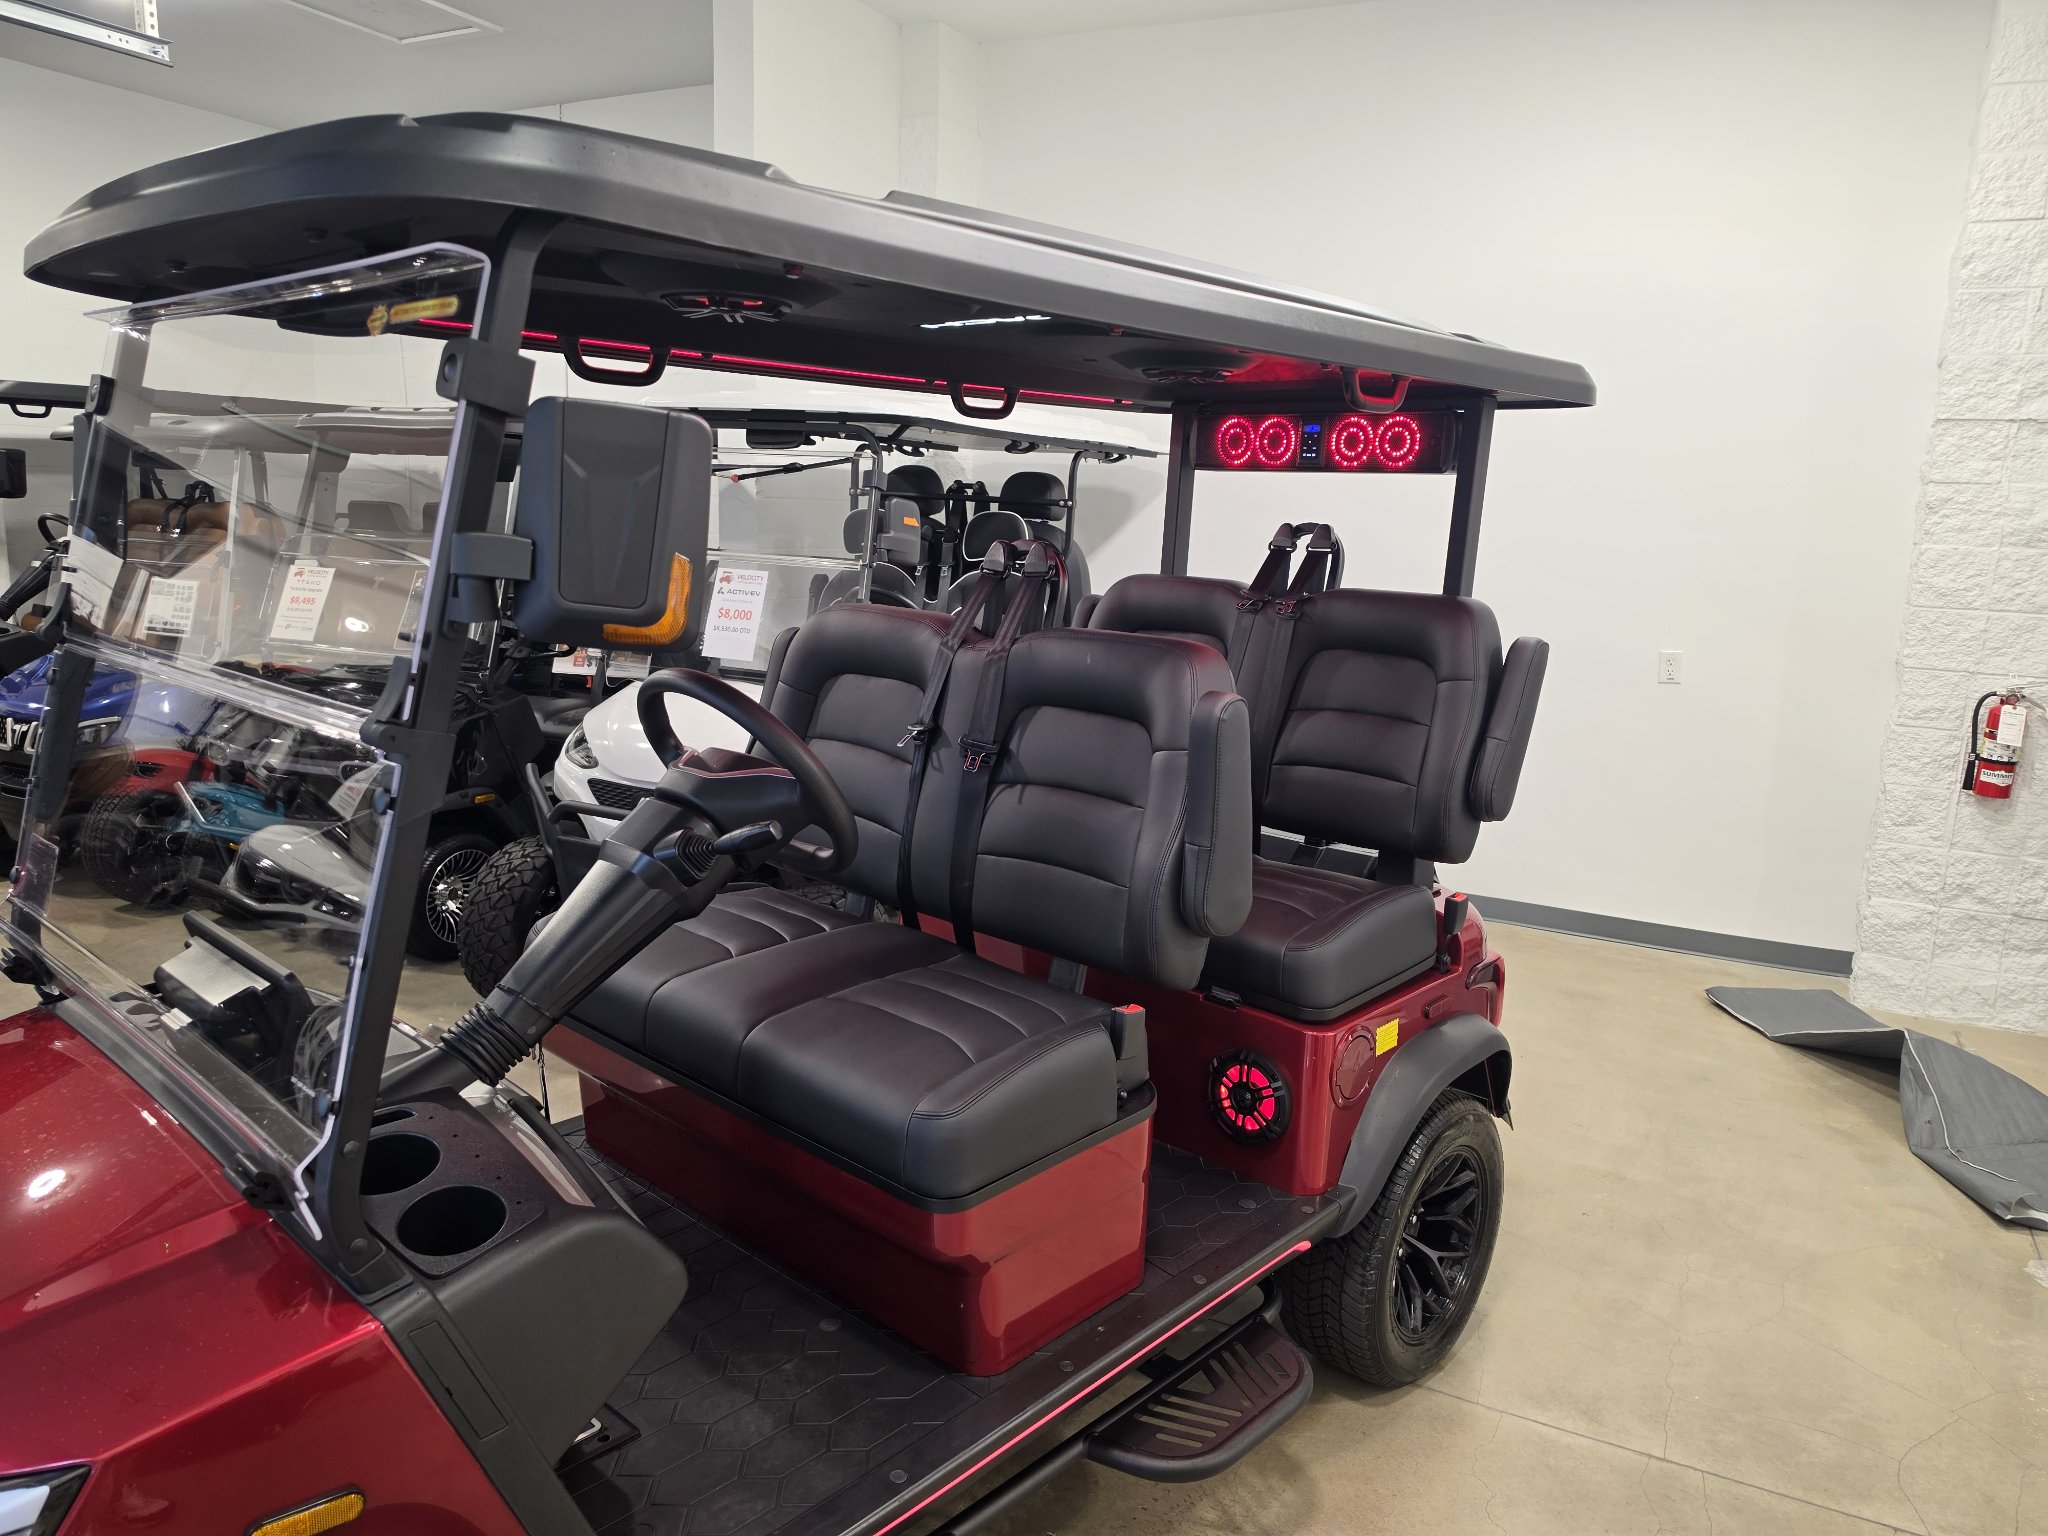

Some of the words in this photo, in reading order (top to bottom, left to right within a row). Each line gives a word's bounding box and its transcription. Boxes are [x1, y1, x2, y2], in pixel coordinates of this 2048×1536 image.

[290, 595, 316, 606] $9,495
[718, 606, 752, 621] $8,000
[1982, 770, 2012, 779] SUMMIT
